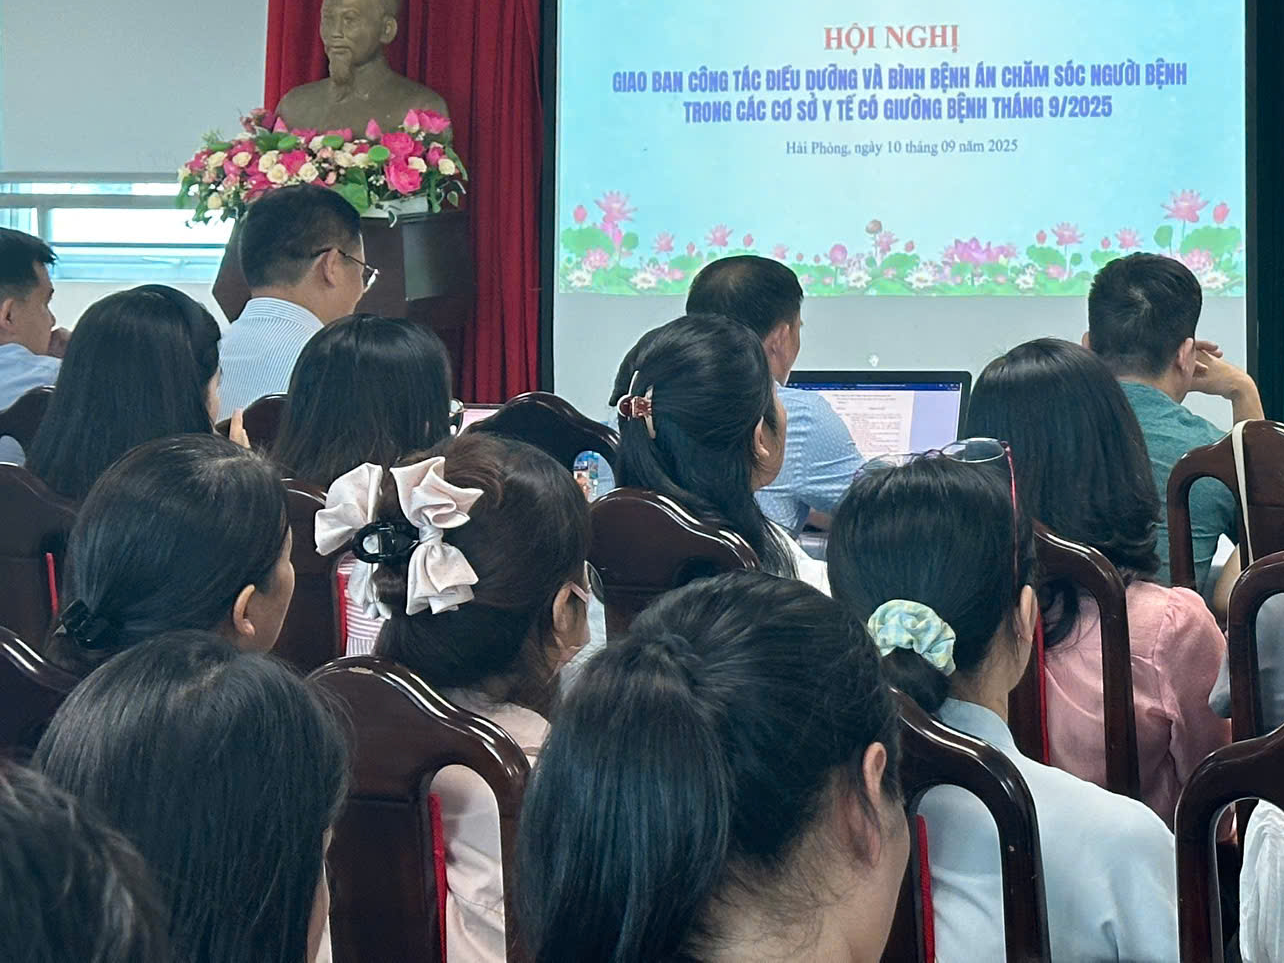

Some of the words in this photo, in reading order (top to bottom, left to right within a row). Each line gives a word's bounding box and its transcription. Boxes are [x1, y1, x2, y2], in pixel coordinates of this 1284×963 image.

[824, 23, 877, 55] HỘI
[885, 24, 960, 53] NGHỊ
[612, 71, 647, 93] GIAO
[652, 71, 683, 93] BAN
[688, 66, 729, 92] CÔNG
[733, 64, 761, 91] TÁC
[863, 63, 883, 90] VÀ
[888, 63, 925, 89] BÌNH
[930, 61, 970, 93] BỆNH
[975, 61, 996, 88] ÁN
[1001, 60, 1049, 88] CHĂM
[1054, 59, 1085, 87] SÓC
[1091, 58, 1140, 86] NGƯỜI
[1145, 57, 1187, 90] BỆNH
[683, 101, 731, 123] TRONG
[736, 96, 766, 122] CÁC
[771, 98, 792, 121] CƠ
[797, 93, 817, 121] SỞ
[823, 99, 833, 121] Y
[836, 94, 856, 120] TẾ
[858, 95, 878, 120] CÓ
[883, 92, 942, 120] GIƯỜNG
[947, 92, 987, 123] BỆNH
[992, 92, 1043, 119] THÁNG
[1048, 95, 1112, 118] 9/2025
[786, 140, 807, 154] Hải
[811, 141, 851, 157] Phòng,
[854, 141, 882, 157] ngày
[888, 141, 901, 154] 10
[905, 140, 938, 156] tháng
[941, 140, 956, 153] 09
[959, 140, 985, 153] năm
[988, 139, 1018, 153] 2025
